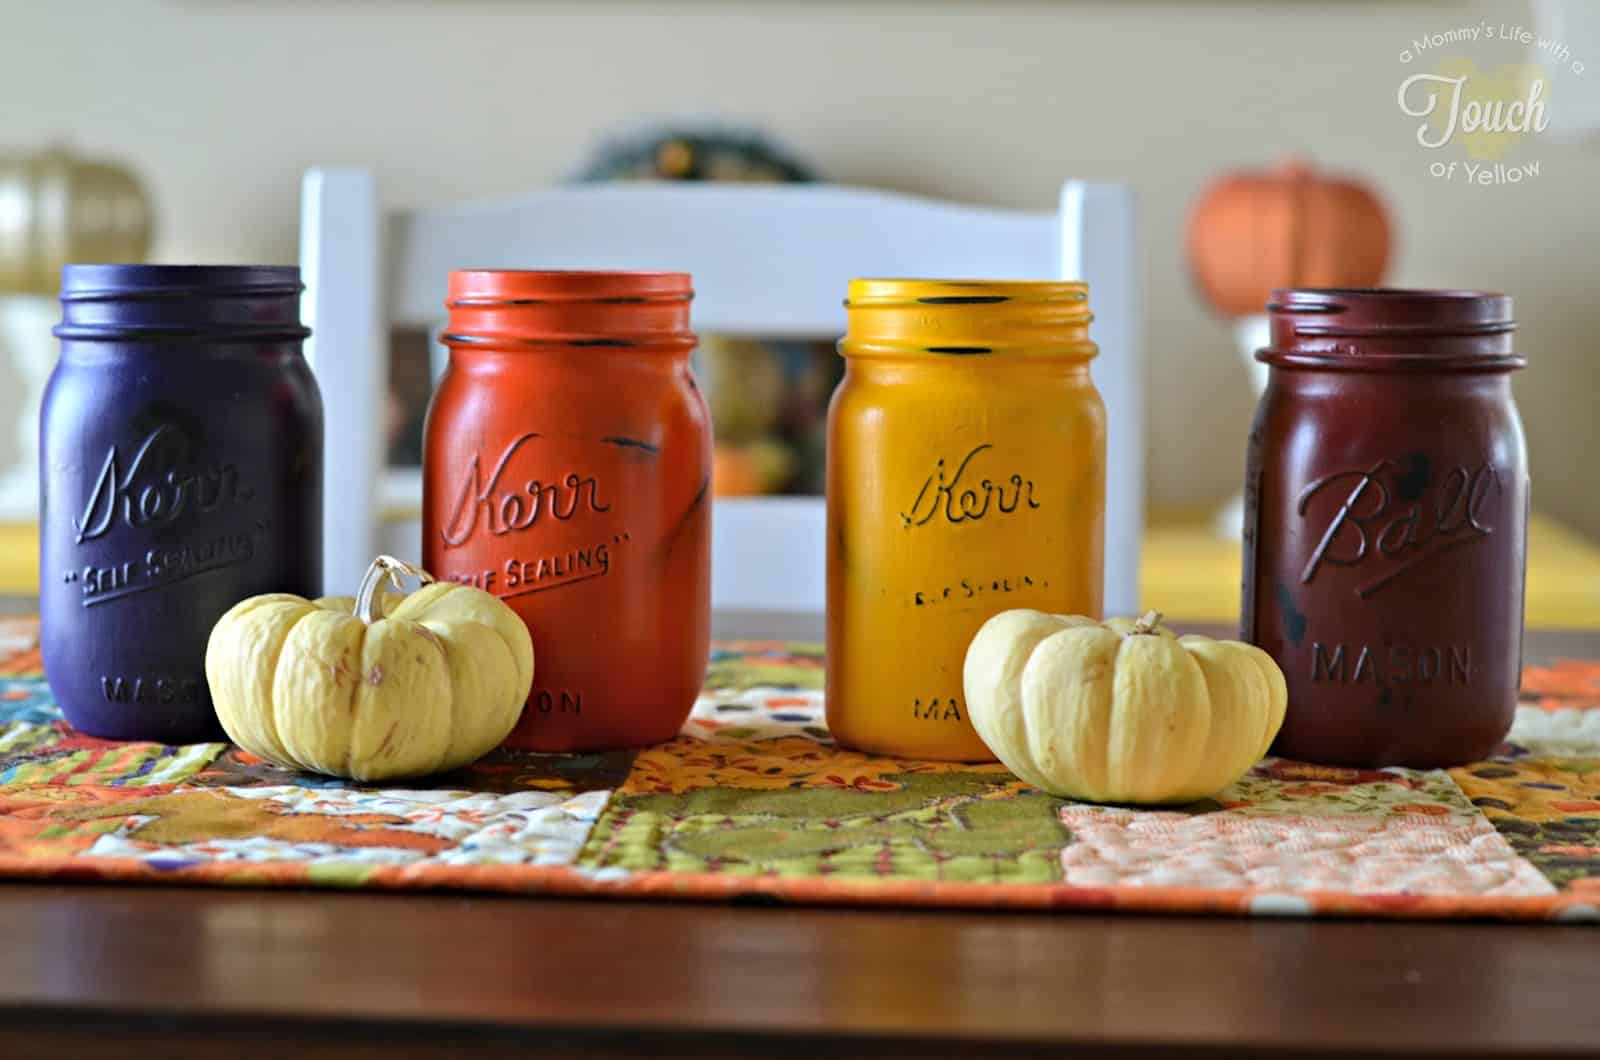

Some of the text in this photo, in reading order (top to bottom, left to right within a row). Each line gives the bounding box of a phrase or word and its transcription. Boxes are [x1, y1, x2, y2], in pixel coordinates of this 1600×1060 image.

[72, 424, 256, 544] Kerr
[440, 432, 611, 550] Kerr
[900, 443, 1040, 529] Kerr
[1298, 458, 1502, 585] Ball
[537, 689, 584, 715] ON
[1311, 641, 1473, 687] MASON
[914, 698, 961, 721] MA
